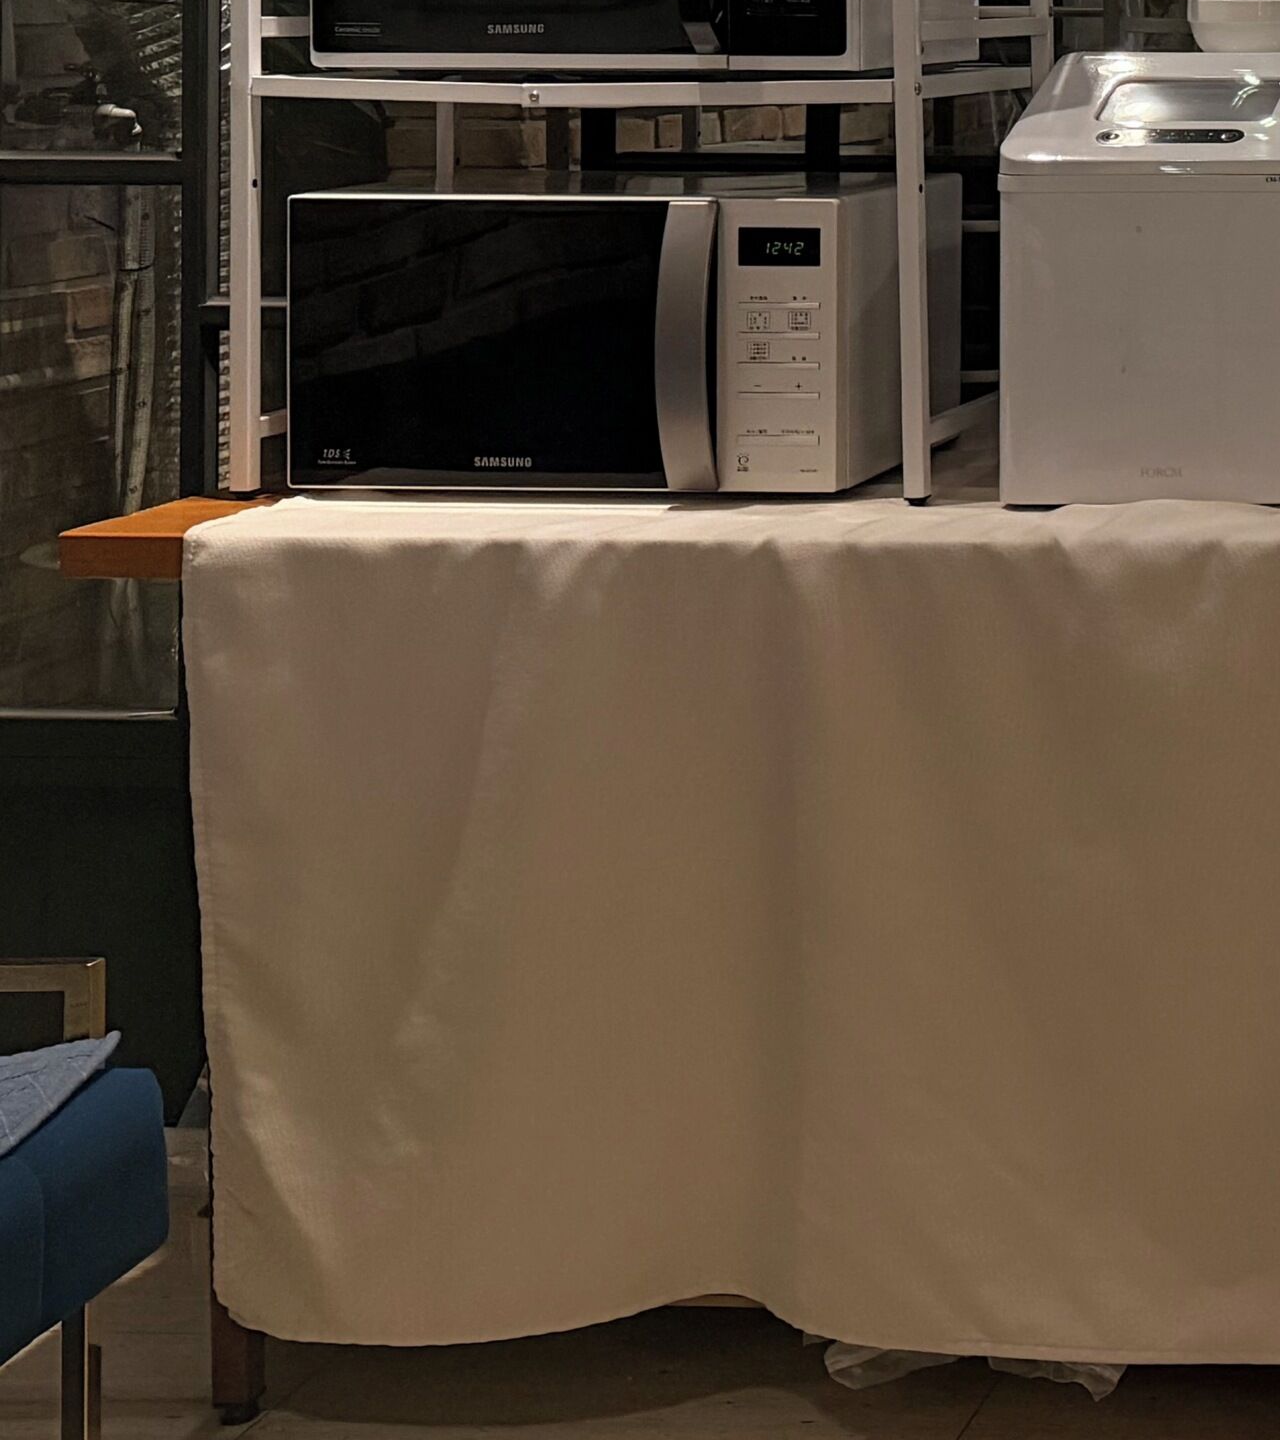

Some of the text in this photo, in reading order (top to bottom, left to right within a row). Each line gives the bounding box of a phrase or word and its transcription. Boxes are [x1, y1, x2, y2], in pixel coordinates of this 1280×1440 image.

[487, 24, 545, 34] SAMSUNG
[765, 241, 805, 255] 1242
[474, 456, 532, 468] SAMSUNG
